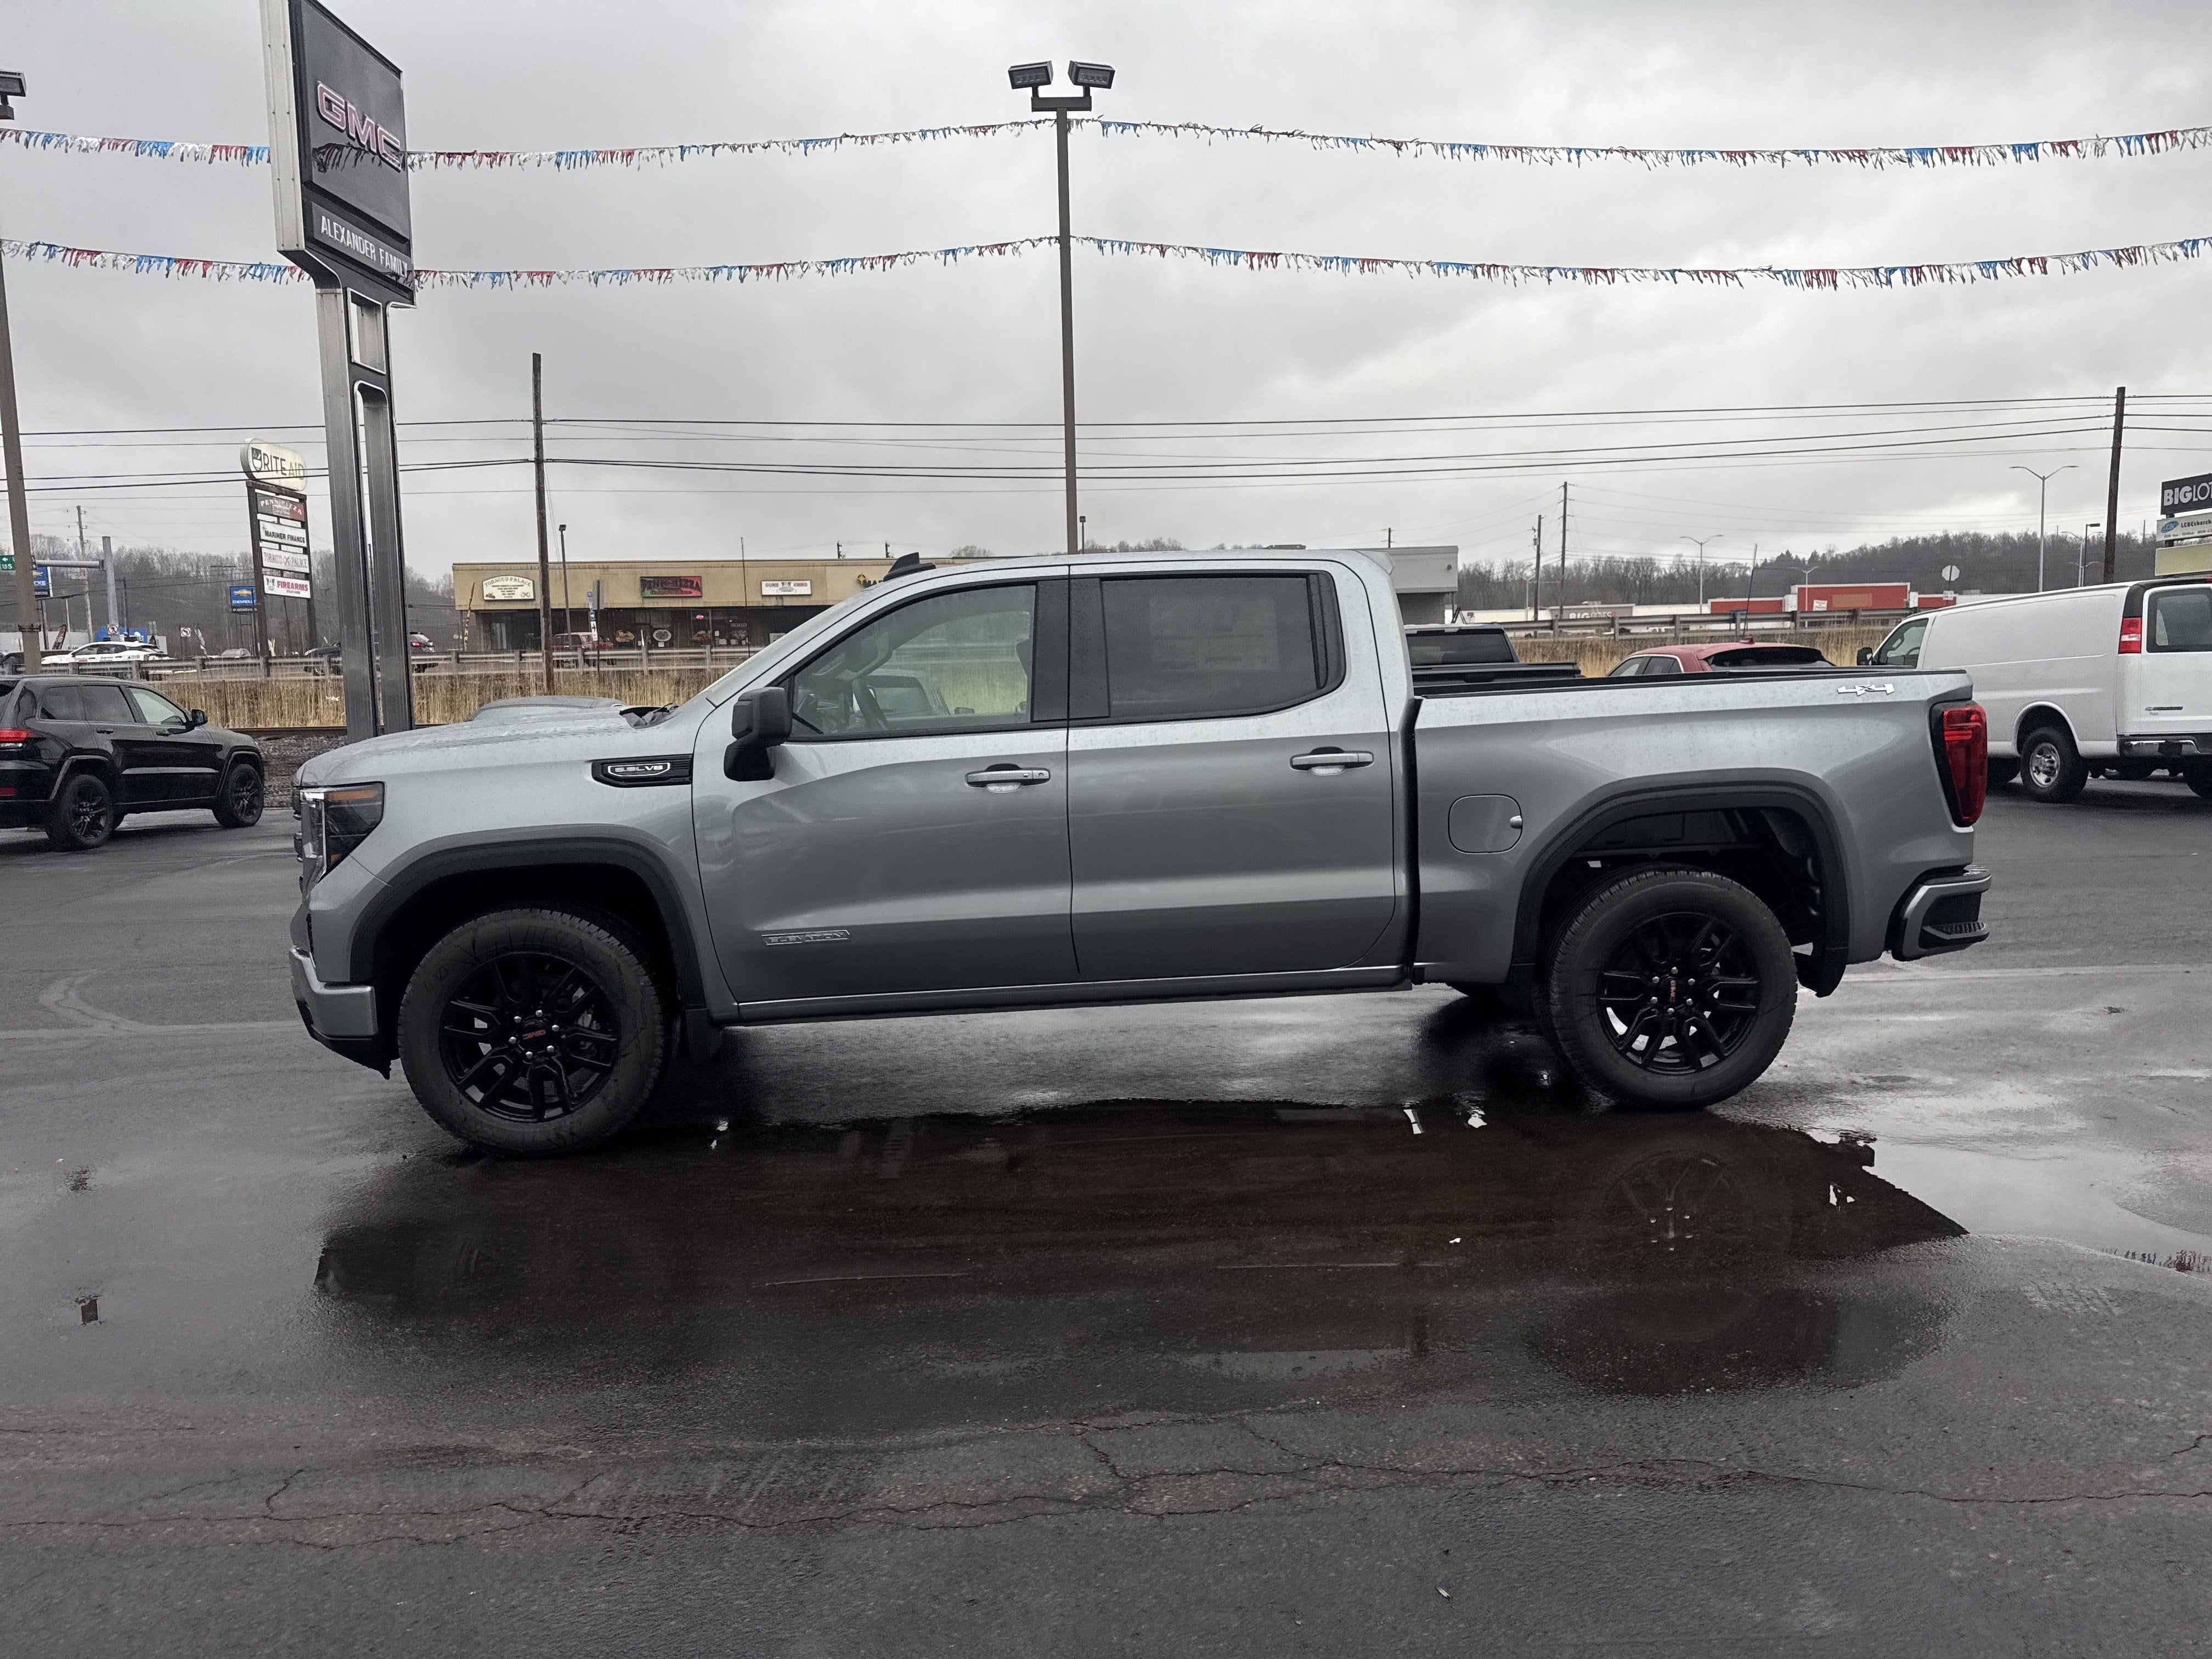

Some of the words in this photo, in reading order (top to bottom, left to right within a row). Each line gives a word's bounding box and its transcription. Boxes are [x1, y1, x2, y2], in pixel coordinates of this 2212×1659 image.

[318, 81, 402, 170] GMC
[321, 215, 376, 262] ALEXANDER
[379, 248, 408, 278] FAMILY
[263, 453, 287, 476] RITE
[288, 462, 305, 480] AID
[264, 530, 286, 540] MARINER
[287, 534, 305, 544] FINANCE
[276, 580, 308, 592] FIREARMS
[484, 577, 509, 587] TOBACCO
[510, 577, 532, 587] PALACE
[769, 933, 844, 943] ELEVATION
